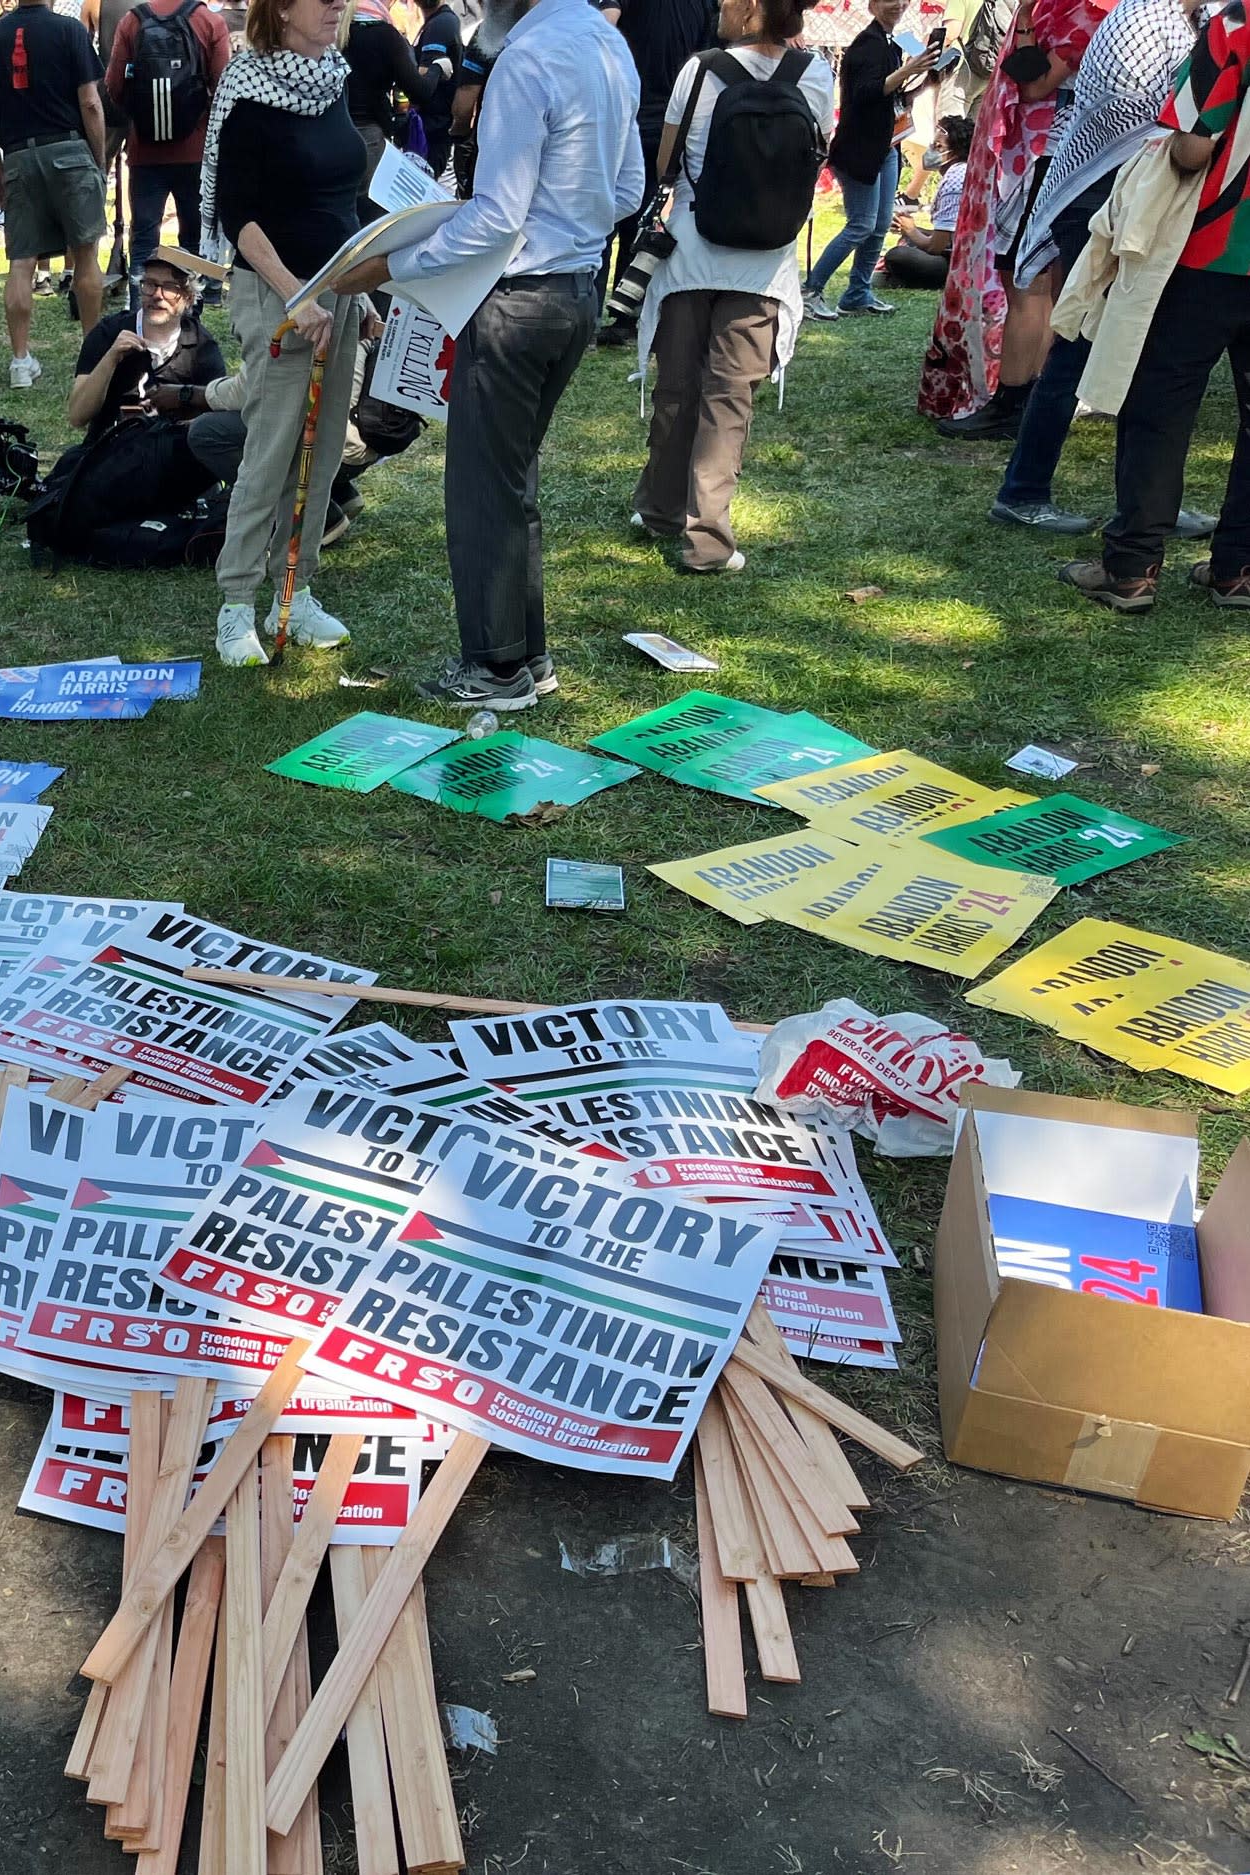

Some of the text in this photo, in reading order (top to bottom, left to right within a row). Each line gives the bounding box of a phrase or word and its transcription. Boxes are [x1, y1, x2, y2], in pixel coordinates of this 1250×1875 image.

[397, 330, 445, 406] KILLING
[59, 681, 129, 696] HARRIS
[62, 669, 174, 684] ABANDON
[9, 699, 83, 714] HARRIS
[301, 723, 396, 773] ABANDON
[334, 731, 433, 779] HARRIS '24
[701, 737, 800, 781] ABANDON
[786, 746, 843, 766] '24
[446, 759, 564, 800] HARRIS '24
[850, 783, 963, 836] ABANDON
[967, 808, 1100, 857] ABANDON
[693, 843, 837, 892] ABANDON
[1007, 824, 1145, 876] HARRIS '24
[20, 924, 50, 938] TO
[857, 875, 965, 941] ABANDON
[908, 889, 1017, 957] HARRIS '24
[42, 988, 287, 1082] RESISTANCE
[70, 967, 309, 1056] PALESTINIAN
[471, 1004, 720, 1058] VICTORY
[33, 1019, 213, 1077] FRSO Freedom Road
[562, 1037, 667, 1066] TO THE
[826, 1028, 913, 1092] BEVERAGE DEPOT
[837, 1063, 852, 1075] IF
[134, 1052, 245, 1096] Socialist Organization
[813, 1067, 841, 1088] FIND
[185, 1163, 223, 1187] TO
[362, 1145, 404, 1173] TO
[675, 1162, 764, 1178] Freedom Road
[679, 1170, 816, 1192] Socialist Organization
[462, 1151, 763, 1268] VICTORY
[526, 1219, 649, 1275] TO THE
[181, 1260, 315, 1318] FRSO
[772, 1286, 808, 1301] Road
[775, 1297, 864, 1321] Organization
[51, 1311, 262, 1354] FRSO Freedom
[377, 1249, 718, 1379] PALESTINIAN
[198, 1343, 261, 1364] Socialist
[347, 1288, 696, 1425] RESISTANCE
[339, 1338, 600, 1439] FRSO Freedom Road
[487, 1402, 650, 1458] Socialist Organization
